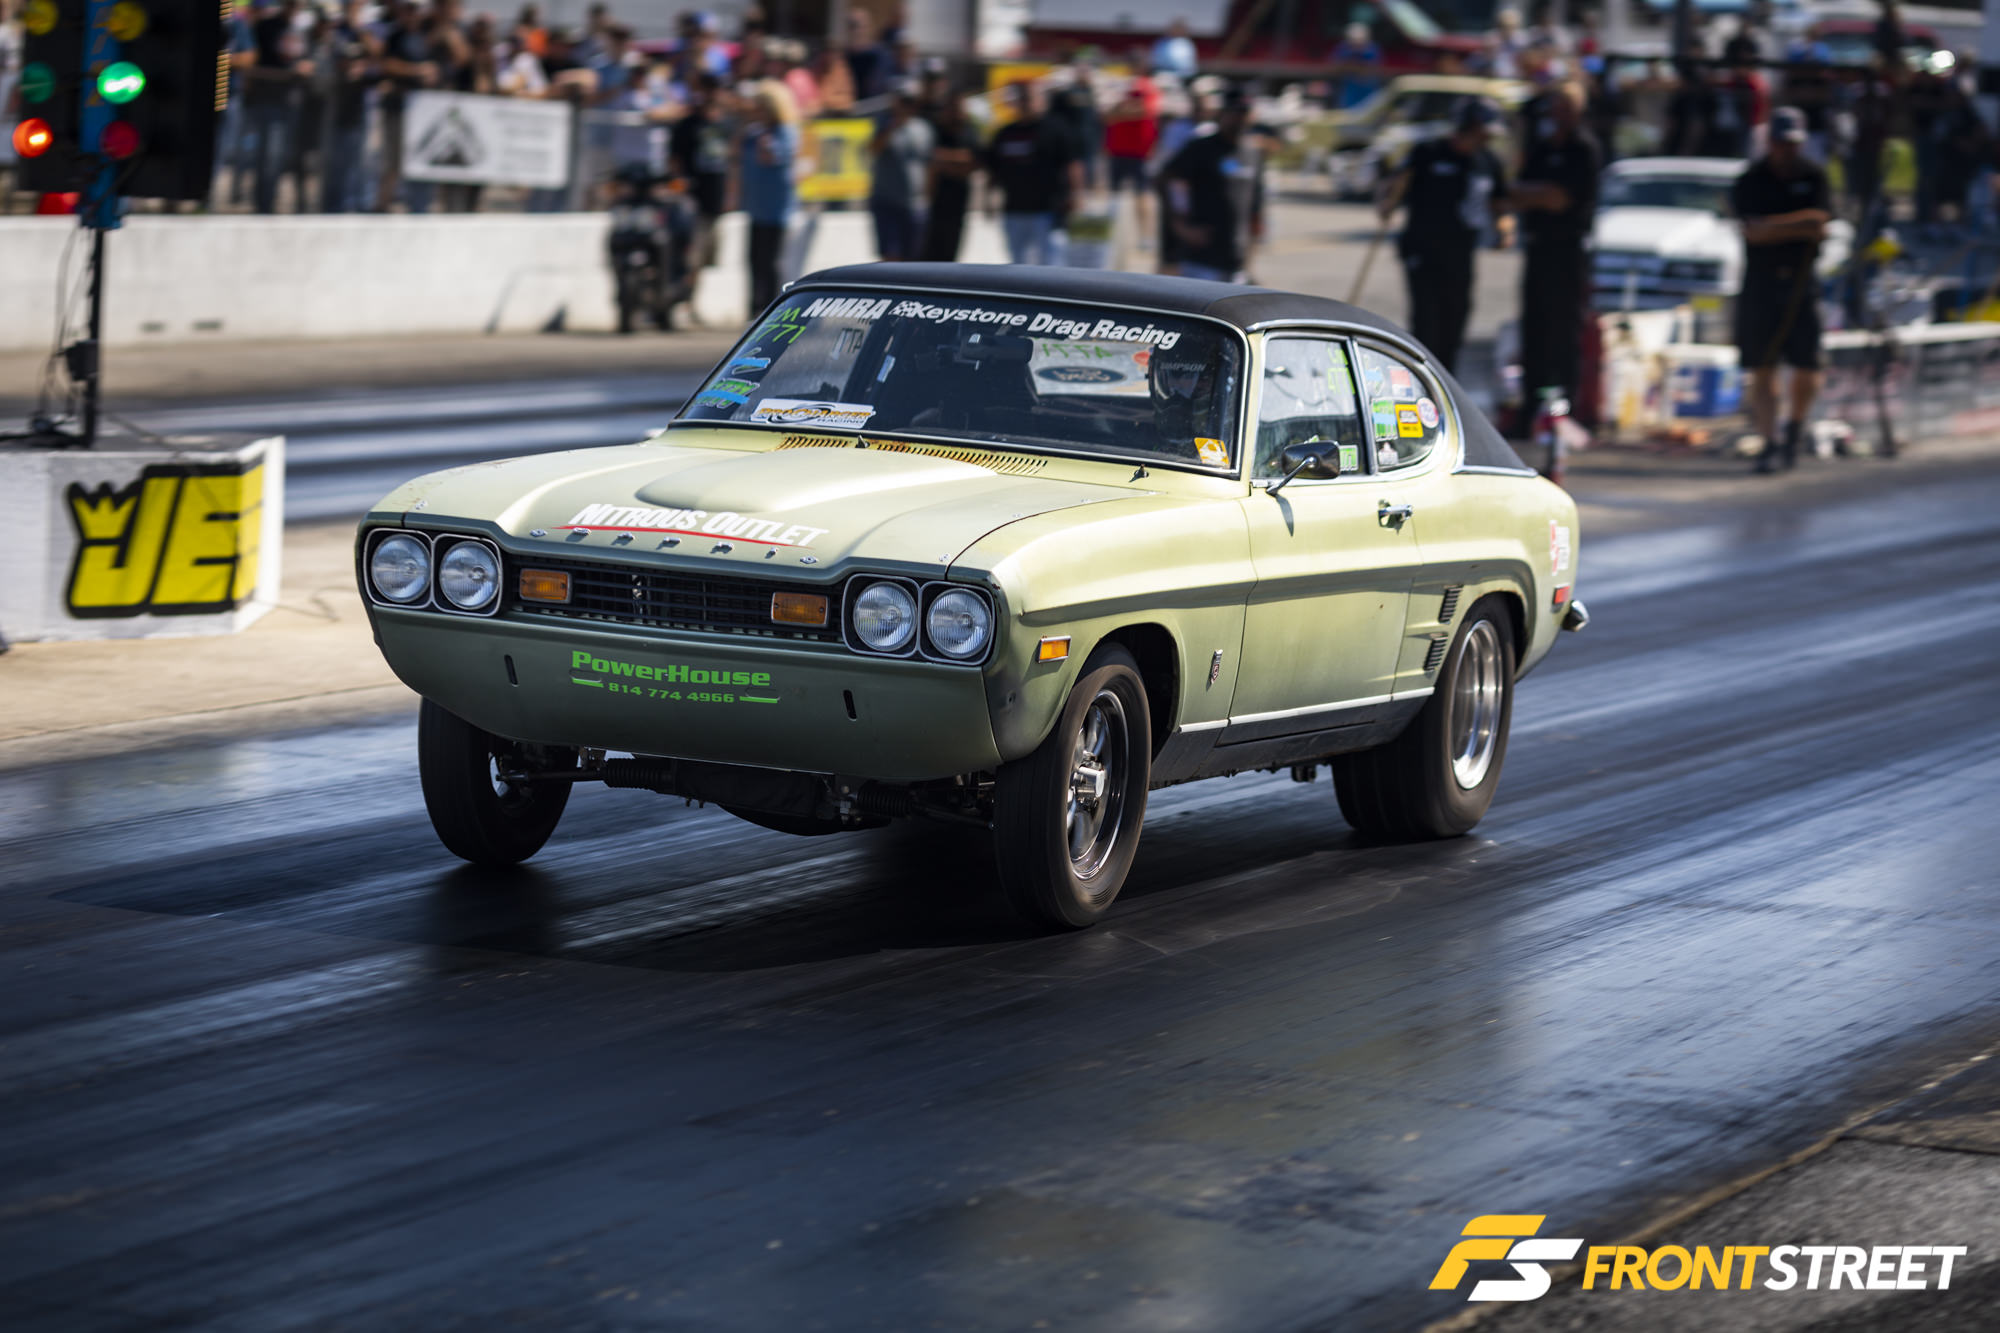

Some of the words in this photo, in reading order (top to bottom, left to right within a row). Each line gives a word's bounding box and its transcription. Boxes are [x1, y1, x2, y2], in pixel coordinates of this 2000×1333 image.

[800, 298, 893, 320] NMRA
[907, 302, 1028, 325] Keystone
[1027, 313, 1092, 341] Drag
[1090, 320, 1181, 350] Racing
[571, 650, 771, 687] PowerHouse
[608, 682, 643, 696] 814
[647, 687, 682, 701] 774
[686, 691, 735, 704] 4966
